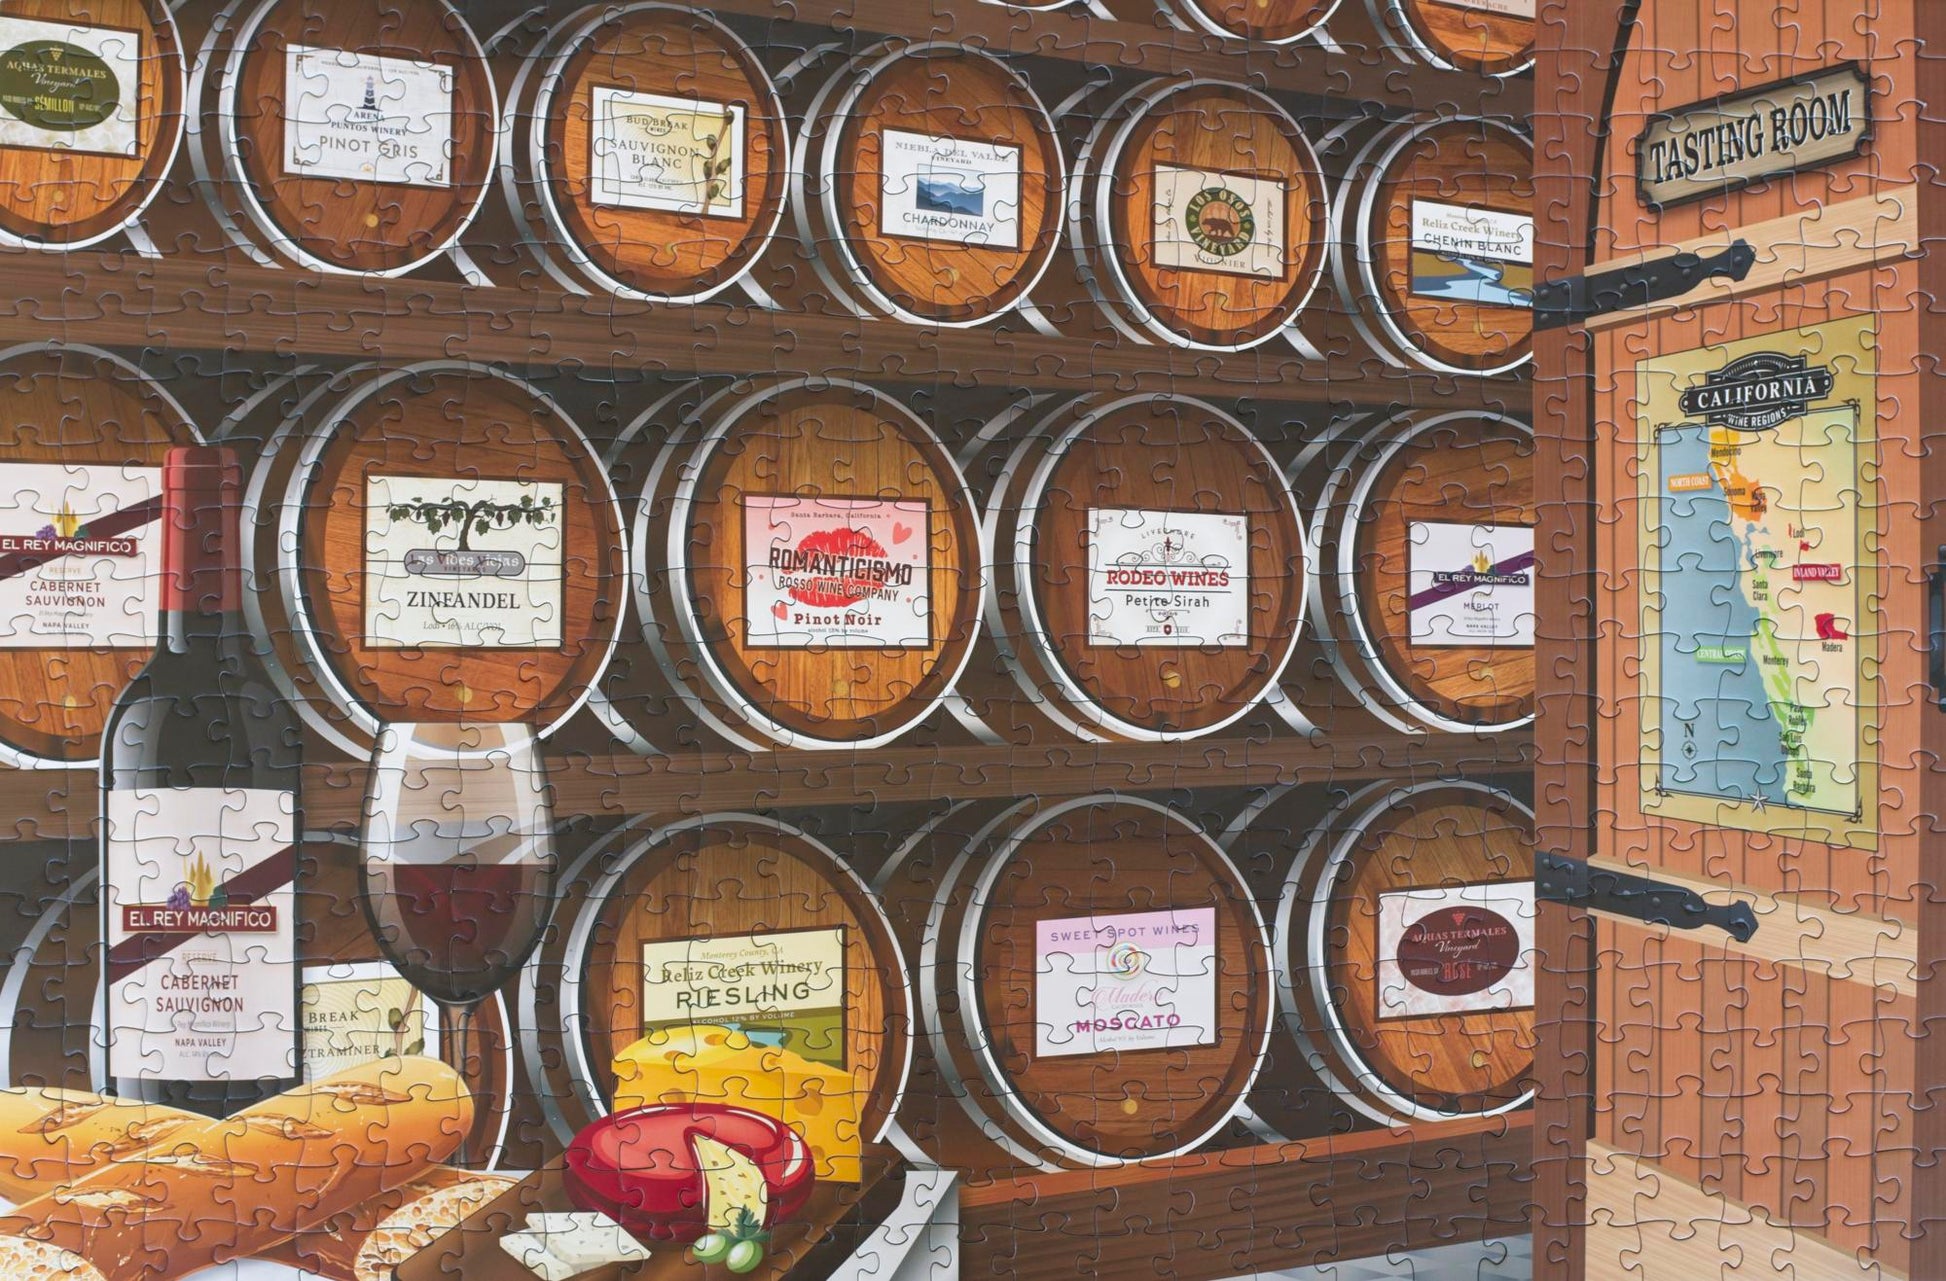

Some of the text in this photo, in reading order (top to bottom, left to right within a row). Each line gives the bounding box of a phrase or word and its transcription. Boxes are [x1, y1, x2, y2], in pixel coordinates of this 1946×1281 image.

[48, 65, 106, 78] TERMALES
[30, 72, 79, 93] Vineyard
[34, 94, 74, 113] SÉMILLON
[354, 111, 384, 122] ARENA
[626, 115, 688, 130] BUD BREAK
[331, 122, 408, 137] PUNTOS WINERY
[1650, 89, 1852, 184] TASTING ROOM
[320, 135, 418, 159] PINOT GRIS
[611, 139, 699, 157] SAUVIGNON
[896, 142, 1009, 162] NIEBLA DEL VALLE
[632, 154, 682, 169] BLANC
[932, 156, 972, 165] VINEYARD
[1190, 190, 1250, 217] LOS OSOS
[902, 212, 996, 232] CHARDONNAY
[1422, 218, 1448, 229] Reliz
[1451, 222, 1481, 234] Creek
[1484, 226, 1521, 239] Winery
[1190, 226, 1250, 256] VINEYARD
[1424, 233, 1521, 256] CHENIN BLANC
[1698, 376, 1816, 409] CALIFORNIA
[1728, 407, 1787, 428] WINE REGIONS
[1670, 476, 1709, 487] NORTH COAST
[1793, 528, 1805, 538] Lodi
[2, 538, 131, 552] EL REY MAGNIFICO
[437, 553, 474, 566] Vides
[478, 554, 520, 568] Viejas
[769, 546, 912, 585] ROMANTICISMO
[1106, 570, 1229, 586] RODEO WINES
[1438, 574, 1526, 584] EL REY MAGNIFICO
[1794, 566, 1839, 577] INLAND VALLEY
[30, 580, 101, 593] CABERNET
[778, 575, 899, 602] ROSSO WINE COMPANY
[1752, 580, 1768, 589] Santa
[25, 596, 105, 607] SAUVIGNON
[406, 591, 520, 610] ZINFANDEL
[1126, 595, 1210, 607] Petite Sirah
[1753, 591, 1767, 601] Clara
[1463, 602, 1500, 611] MERLOT
[794, 613, 882, 626] Pinot Noir
[1822, 642, 1843, 652] Madera
[1763, 655, 1788, 667] Monterey
[1684, 723, 1694, 738] N
[130, 911, 271, 927] EL REY MAGNIFICO
[1051, 924, 1200, 942] SWEET SPOT WINES
[1451, 927, 1507, 939] TERMALES
[700, 951, 737, 961] Monterey
[1435, 940, 1480, 958] Vineyard
[662, 960, 823, 983] Reliz Creek Winery
[160, 974, 238, 990] CABERNET
[677, 982, 809, 1008] RIESLING
[156, 996, 243, 1012] SAUVIGNON
[309, 1010, 359, 1023] BREAK
[693, 1016, 728, 1025] ALCOHOL
[762, 1012, 795, 1020] VOLUME
[1076, 1014, 1181, 1033] MOSCATO
[175, 1038, 227, 1047] NAPA VALLEY
